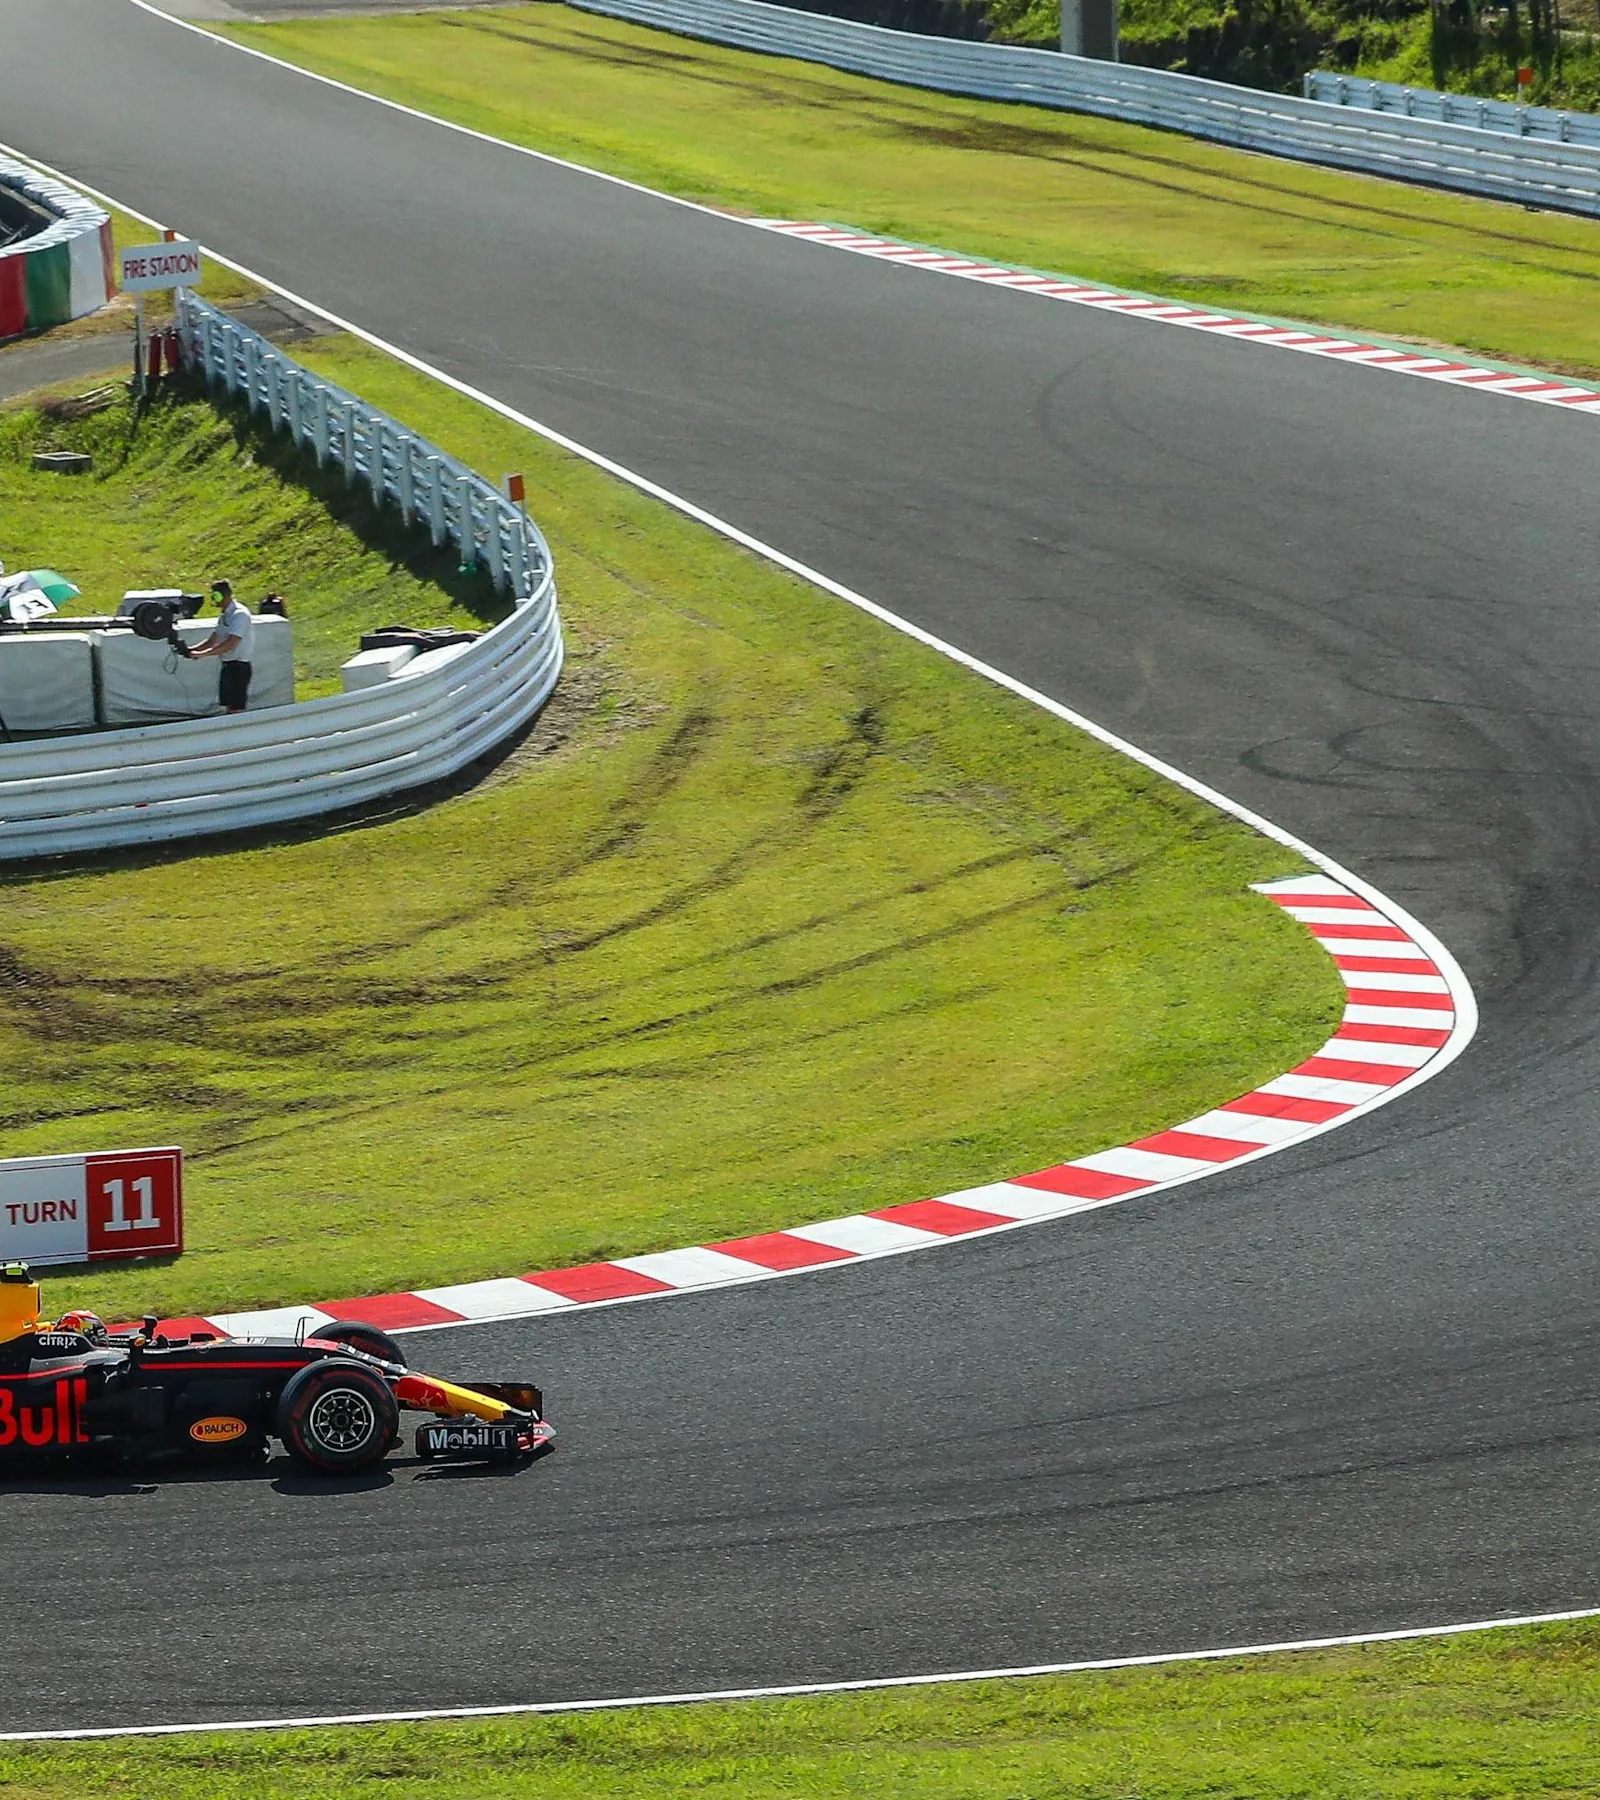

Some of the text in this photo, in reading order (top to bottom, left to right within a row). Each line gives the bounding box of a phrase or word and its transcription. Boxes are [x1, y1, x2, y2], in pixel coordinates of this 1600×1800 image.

[123, 252, 198, 279] FIRE STATION
[6, 1176, 160, 1232] TURN 11
[204, 1423, 239, 1435] RAUCH
[429, 1429, 489, 1449] Mobil
